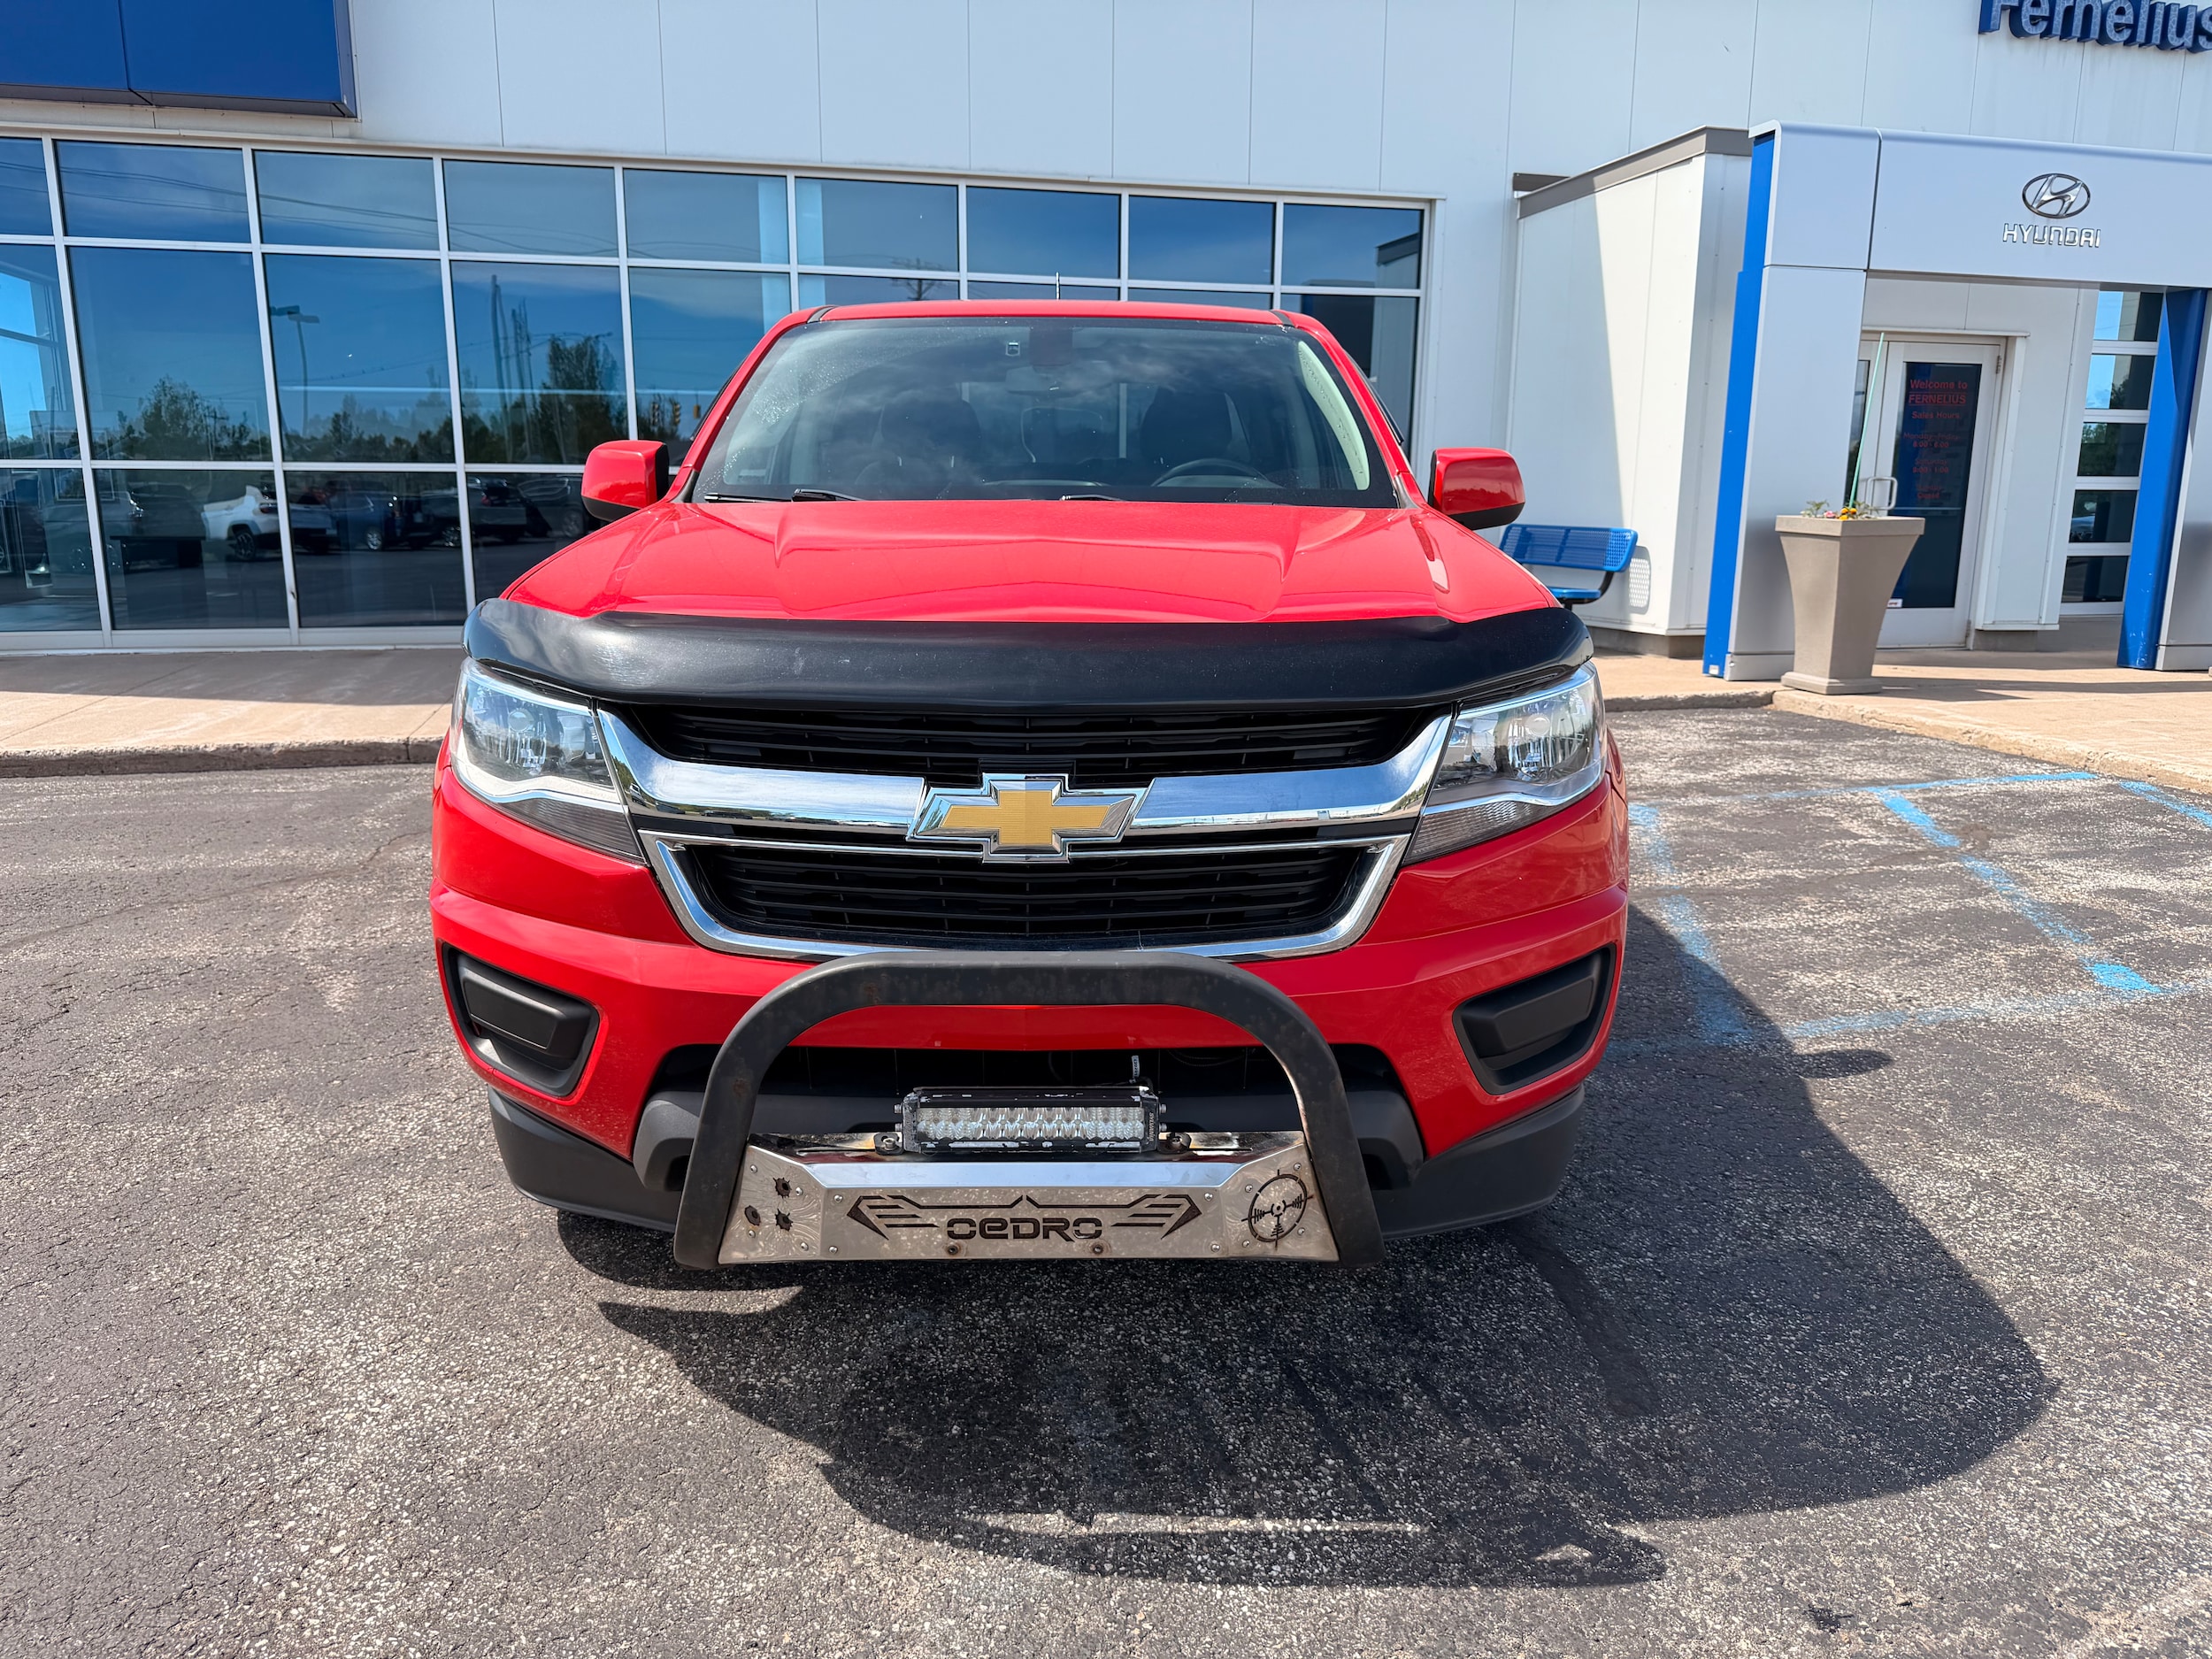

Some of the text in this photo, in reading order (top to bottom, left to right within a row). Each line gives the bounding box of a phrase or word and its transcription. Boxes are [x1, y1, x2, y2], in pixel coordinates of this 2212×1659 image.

[2002, 223, 2101, 249] HYUNDAI
[1909, 380, 1968, 389] Welcome to
[1909, 394, 1966, 404] FERNELIUS
[1912, 411, 1934, 419] Sales
